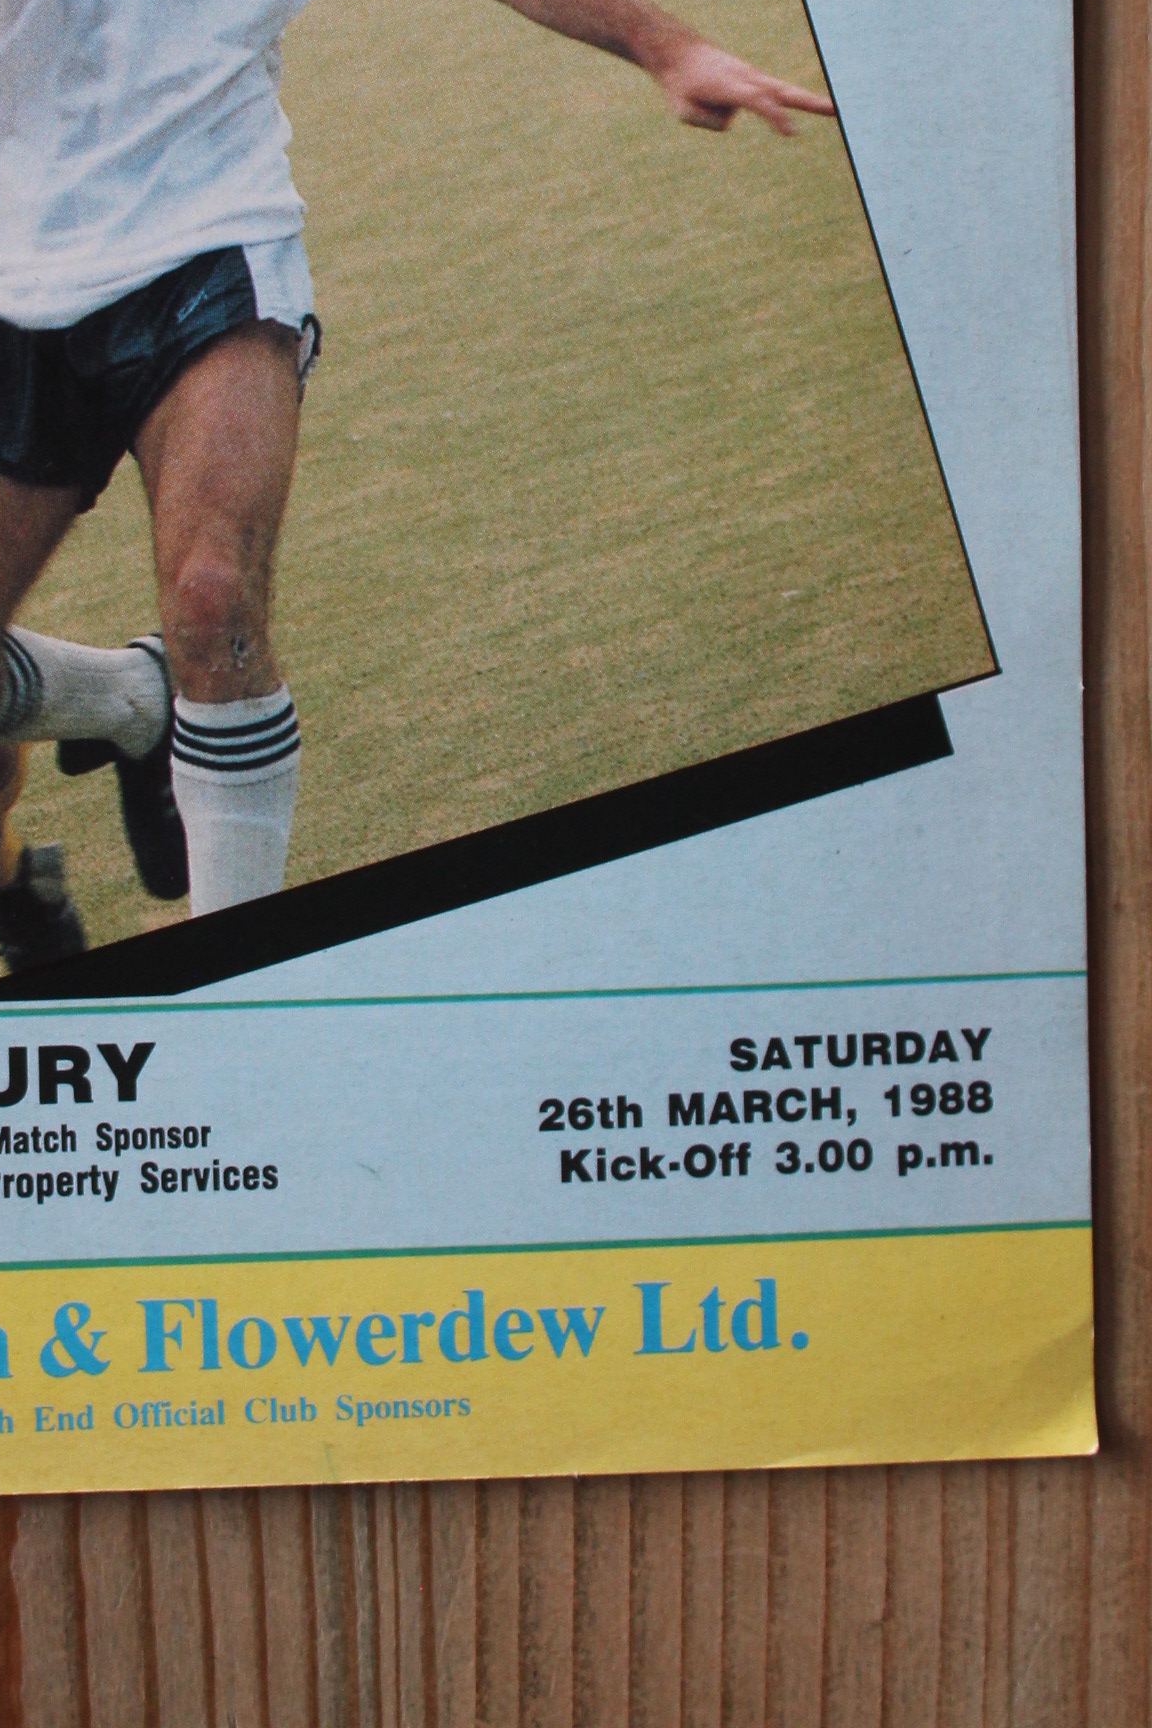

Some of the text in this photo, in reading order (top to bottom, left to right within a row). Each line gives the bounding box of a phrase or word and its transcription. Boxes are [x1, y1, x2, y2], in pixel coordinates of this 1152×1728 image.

[730, 1027, 992, 1073] SATURDAY
[538, 1080, 994, 1133] 26th MARCH, 1988
[95, 1122, 212, 1158] Sponsor
[560, 1138, 994, 1184] Kick-Off 3.00 p.m.
[140, 1159, 279, 1195] Services
[39, 1302, 110, 1378] &
[137, 1289, 605, 1373] Flowerdew
[634, 1278, 809, 1355] Ltd.
[34, 1404, 94, 1432] End
[113, 1399, 225, 1428] Official
[244, 1396, 317, 1424] Club
[336, 1393, 471, 1428] Sponsors
